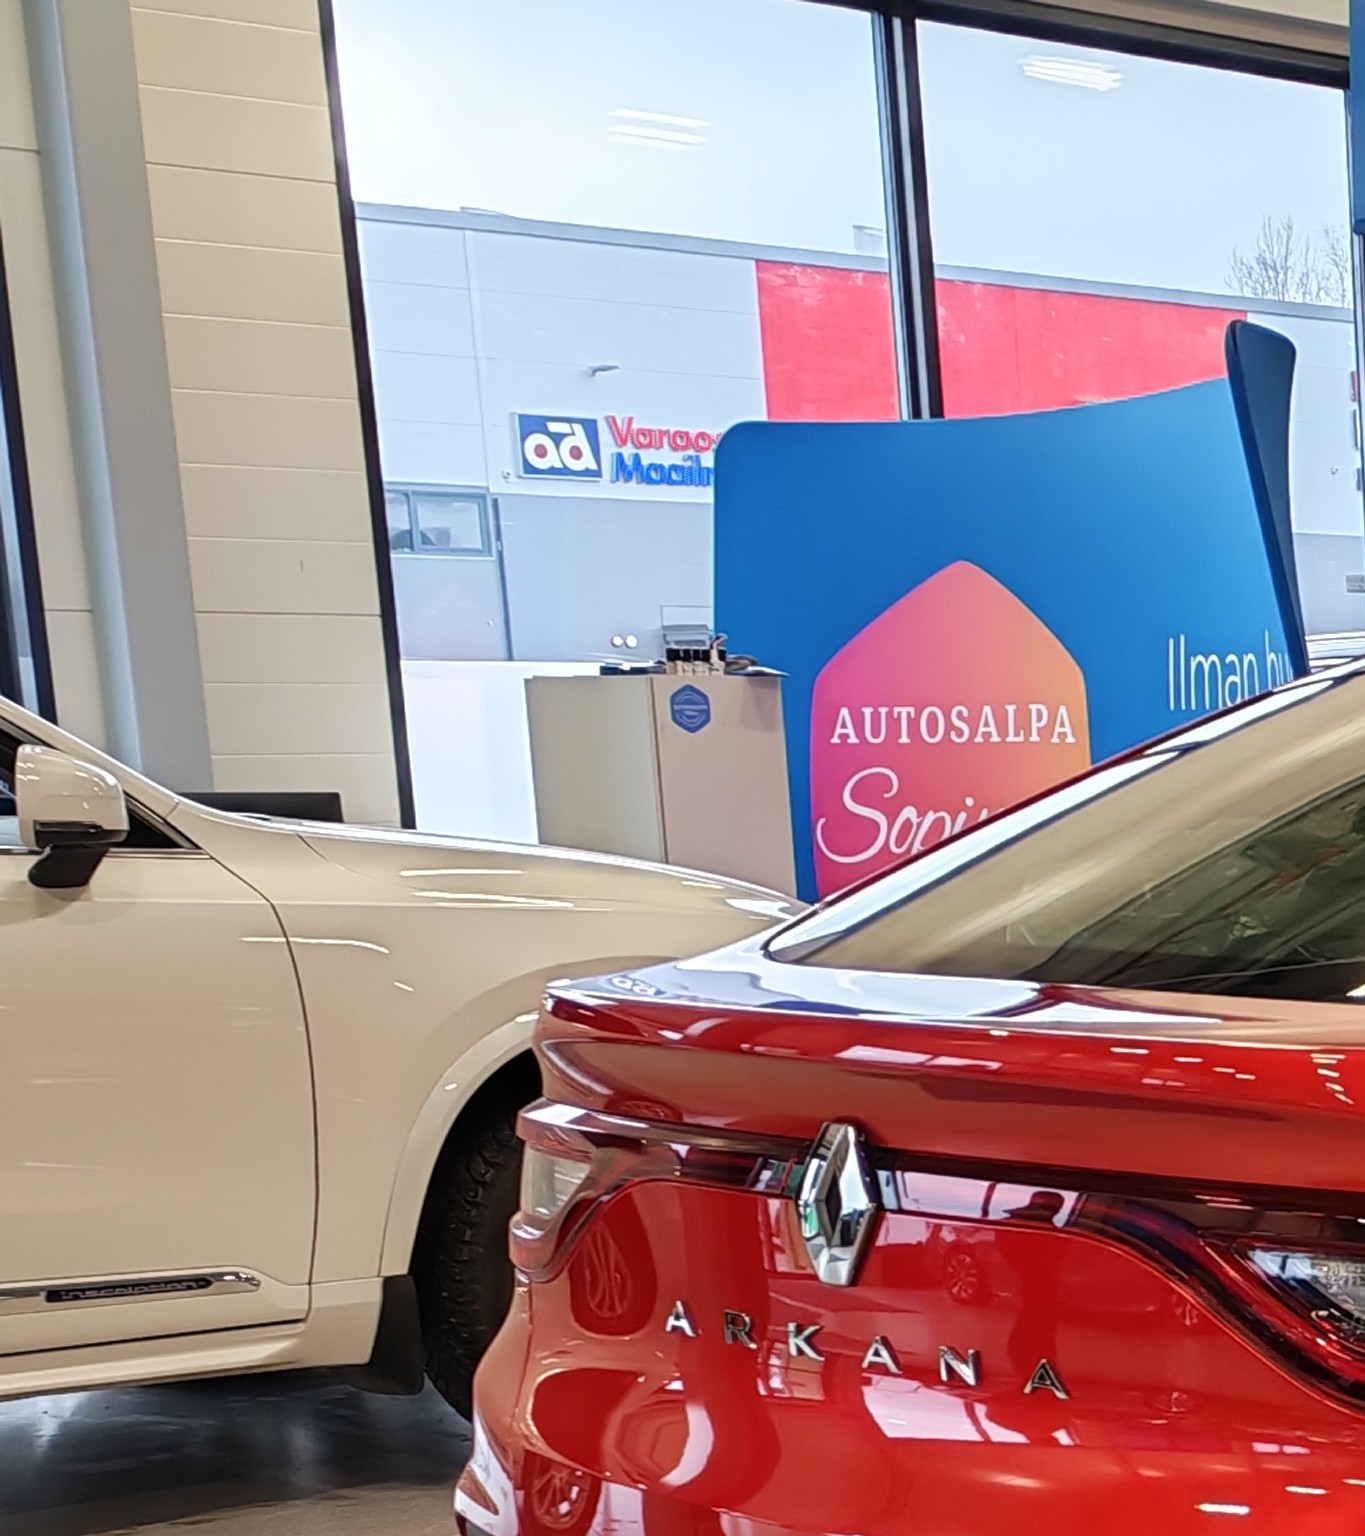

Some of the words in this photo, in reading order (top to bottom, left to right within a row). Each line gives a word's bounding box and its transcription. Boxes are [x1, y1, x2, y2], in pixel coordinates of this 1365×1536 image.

[1168, 633, 1260, 712] Ilman
[830, 703, 1077, 744] AUTOSALPA
[665, 1300, 1070, 1400] ARKANA
